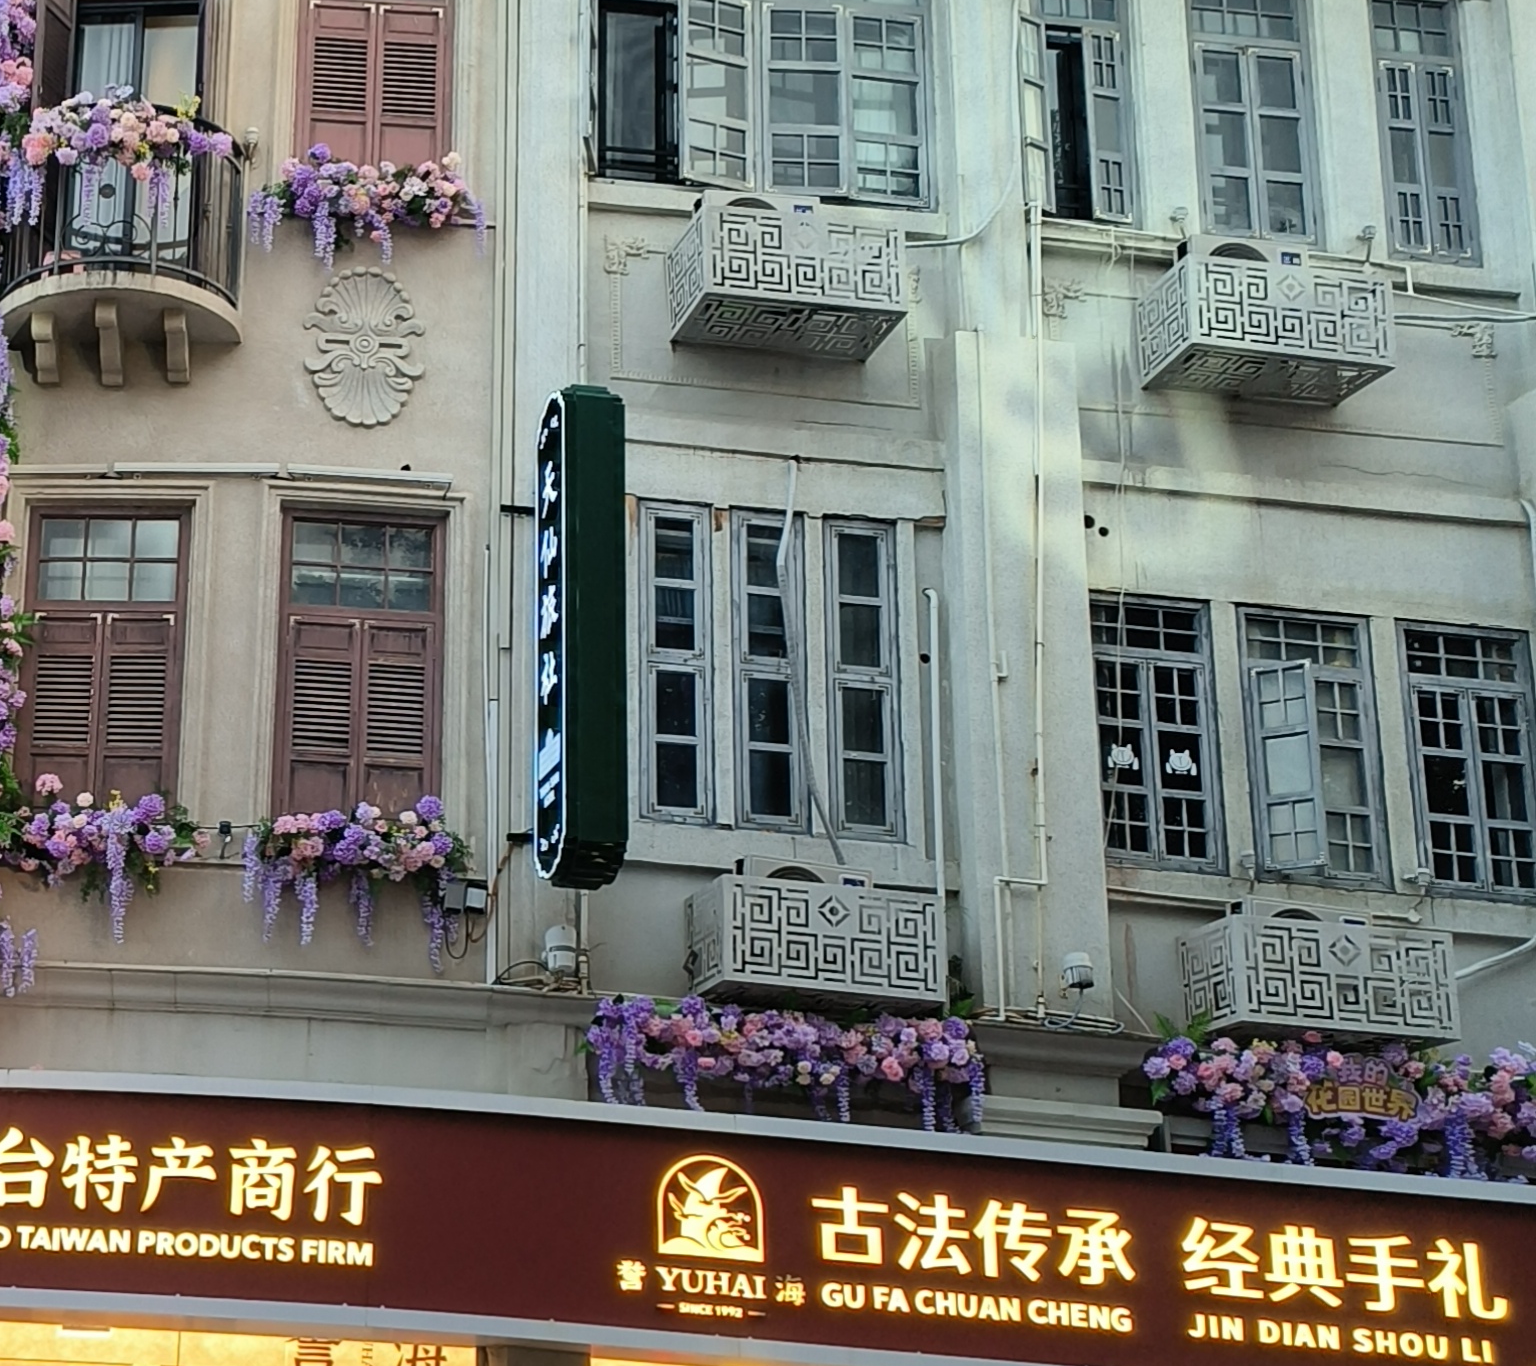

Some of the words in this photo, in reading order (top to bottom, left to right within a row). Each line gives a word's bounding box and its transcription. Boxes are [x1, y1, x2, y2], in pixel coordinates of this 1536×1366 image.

[1306, 1080, 1417, 1121] 花园世界
[17, 1226, 131, 1254] TAIWAN
[137, 1231, 295, 1263] PRODUCTS
[301, 1239, 374, 1267] FIRM
[811, 1186, 1136, 1285] 古法传承
[1181, 1216, 1509, 1320] 经典手礼
[617, 1260, 646, 1291] 誉
[655, 1266, 767, 1299] YUHAI
[775, 1274, 806, 1306] 海
[715, 1304, 743, 1318] 1992
[821, 1282, 866, 1308] GU
[873, 1286, 910, 1313] FA
[915, 1289, 1022, 1322] CHUAN
[1027, 1300, 1133, 1333] CHENG
[1188, 1313, 1244, 1341] JIN
[1257, 1319, 1341, 1349] DIAN
[1353, 1328, 1449, 1360] SHOU
[1461, 1337, 1495, 1364] LI
